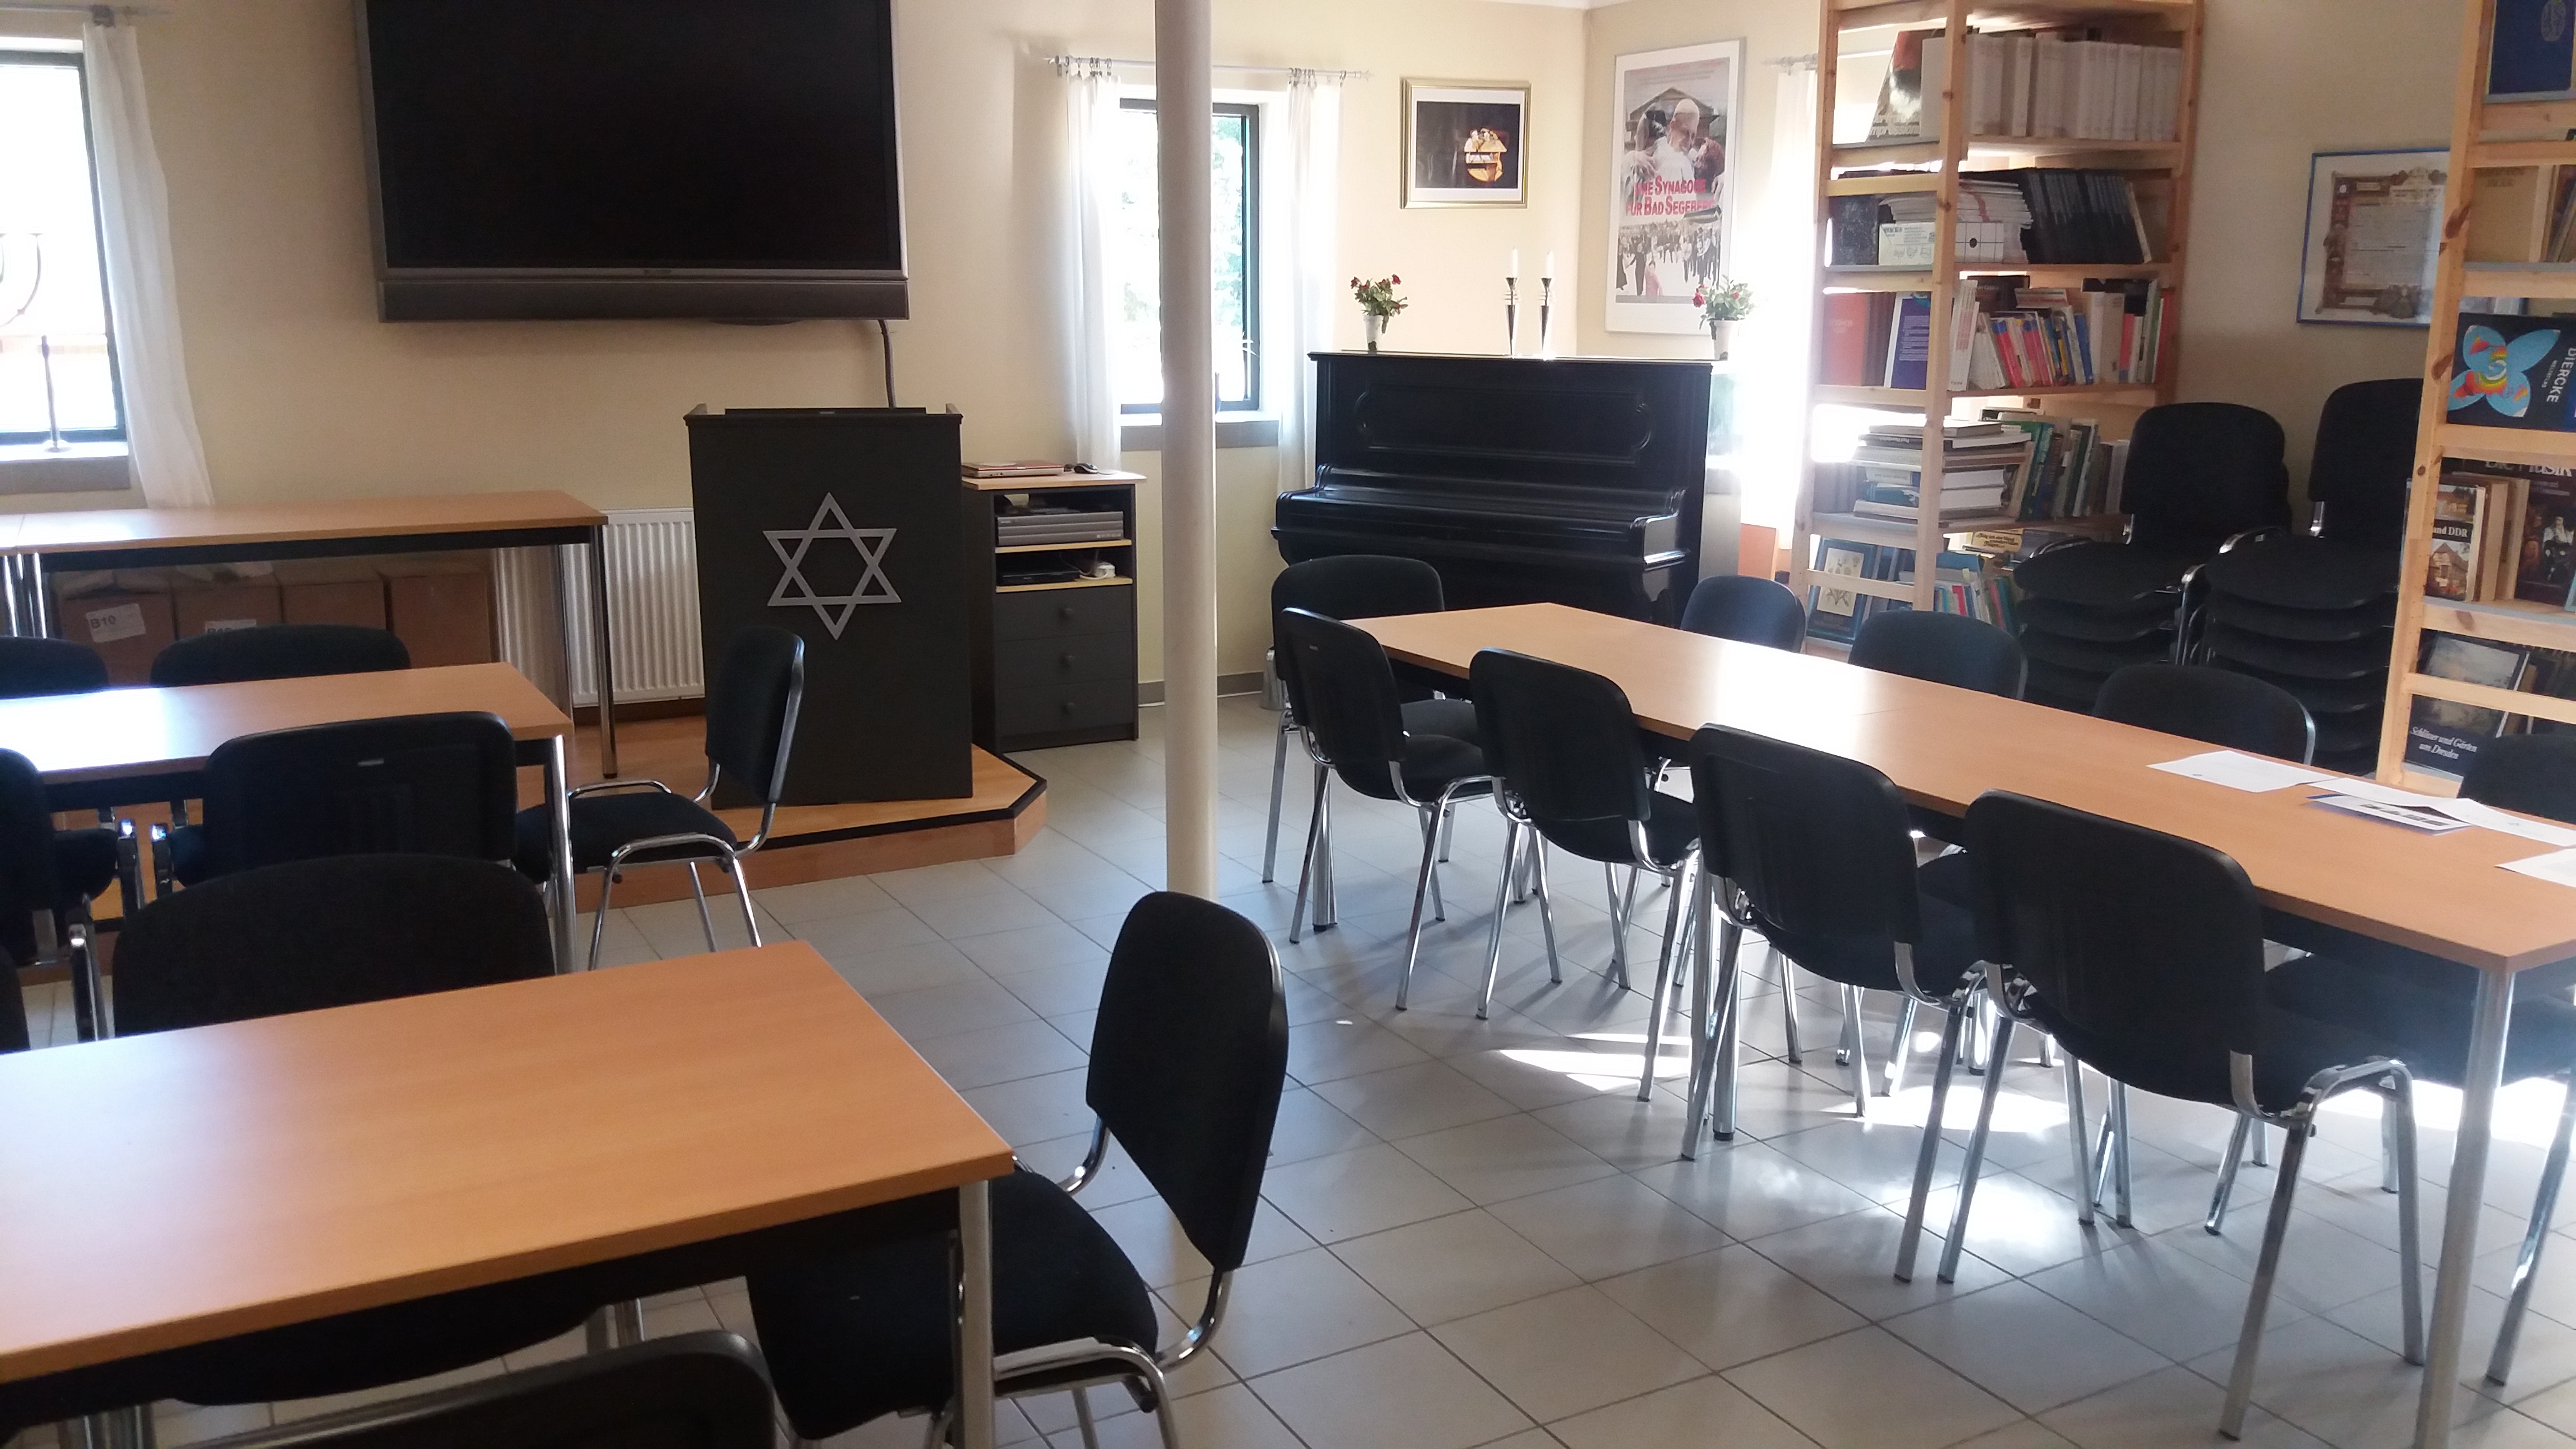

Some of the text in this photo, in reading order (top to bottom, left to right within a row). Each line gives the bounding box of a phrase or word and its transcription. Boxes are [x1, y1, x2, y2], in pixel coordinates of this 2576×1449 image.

[1655, 175, 1706, 195] SYNAGOGE
[1644, 197, 1664, 215] BAD
[1666, 195, 1715, 215] SEGEBERG
[2547, 348, 2576, 402] DIERCKE
[2448, 526, 2468, 537] DDR
[90, 615, 117, 629] B10
[2431, 744, 2459, 759] Dresden
[2438, 737, 2456, 746] und
[2453, 738, 2477, 753] Gärten
